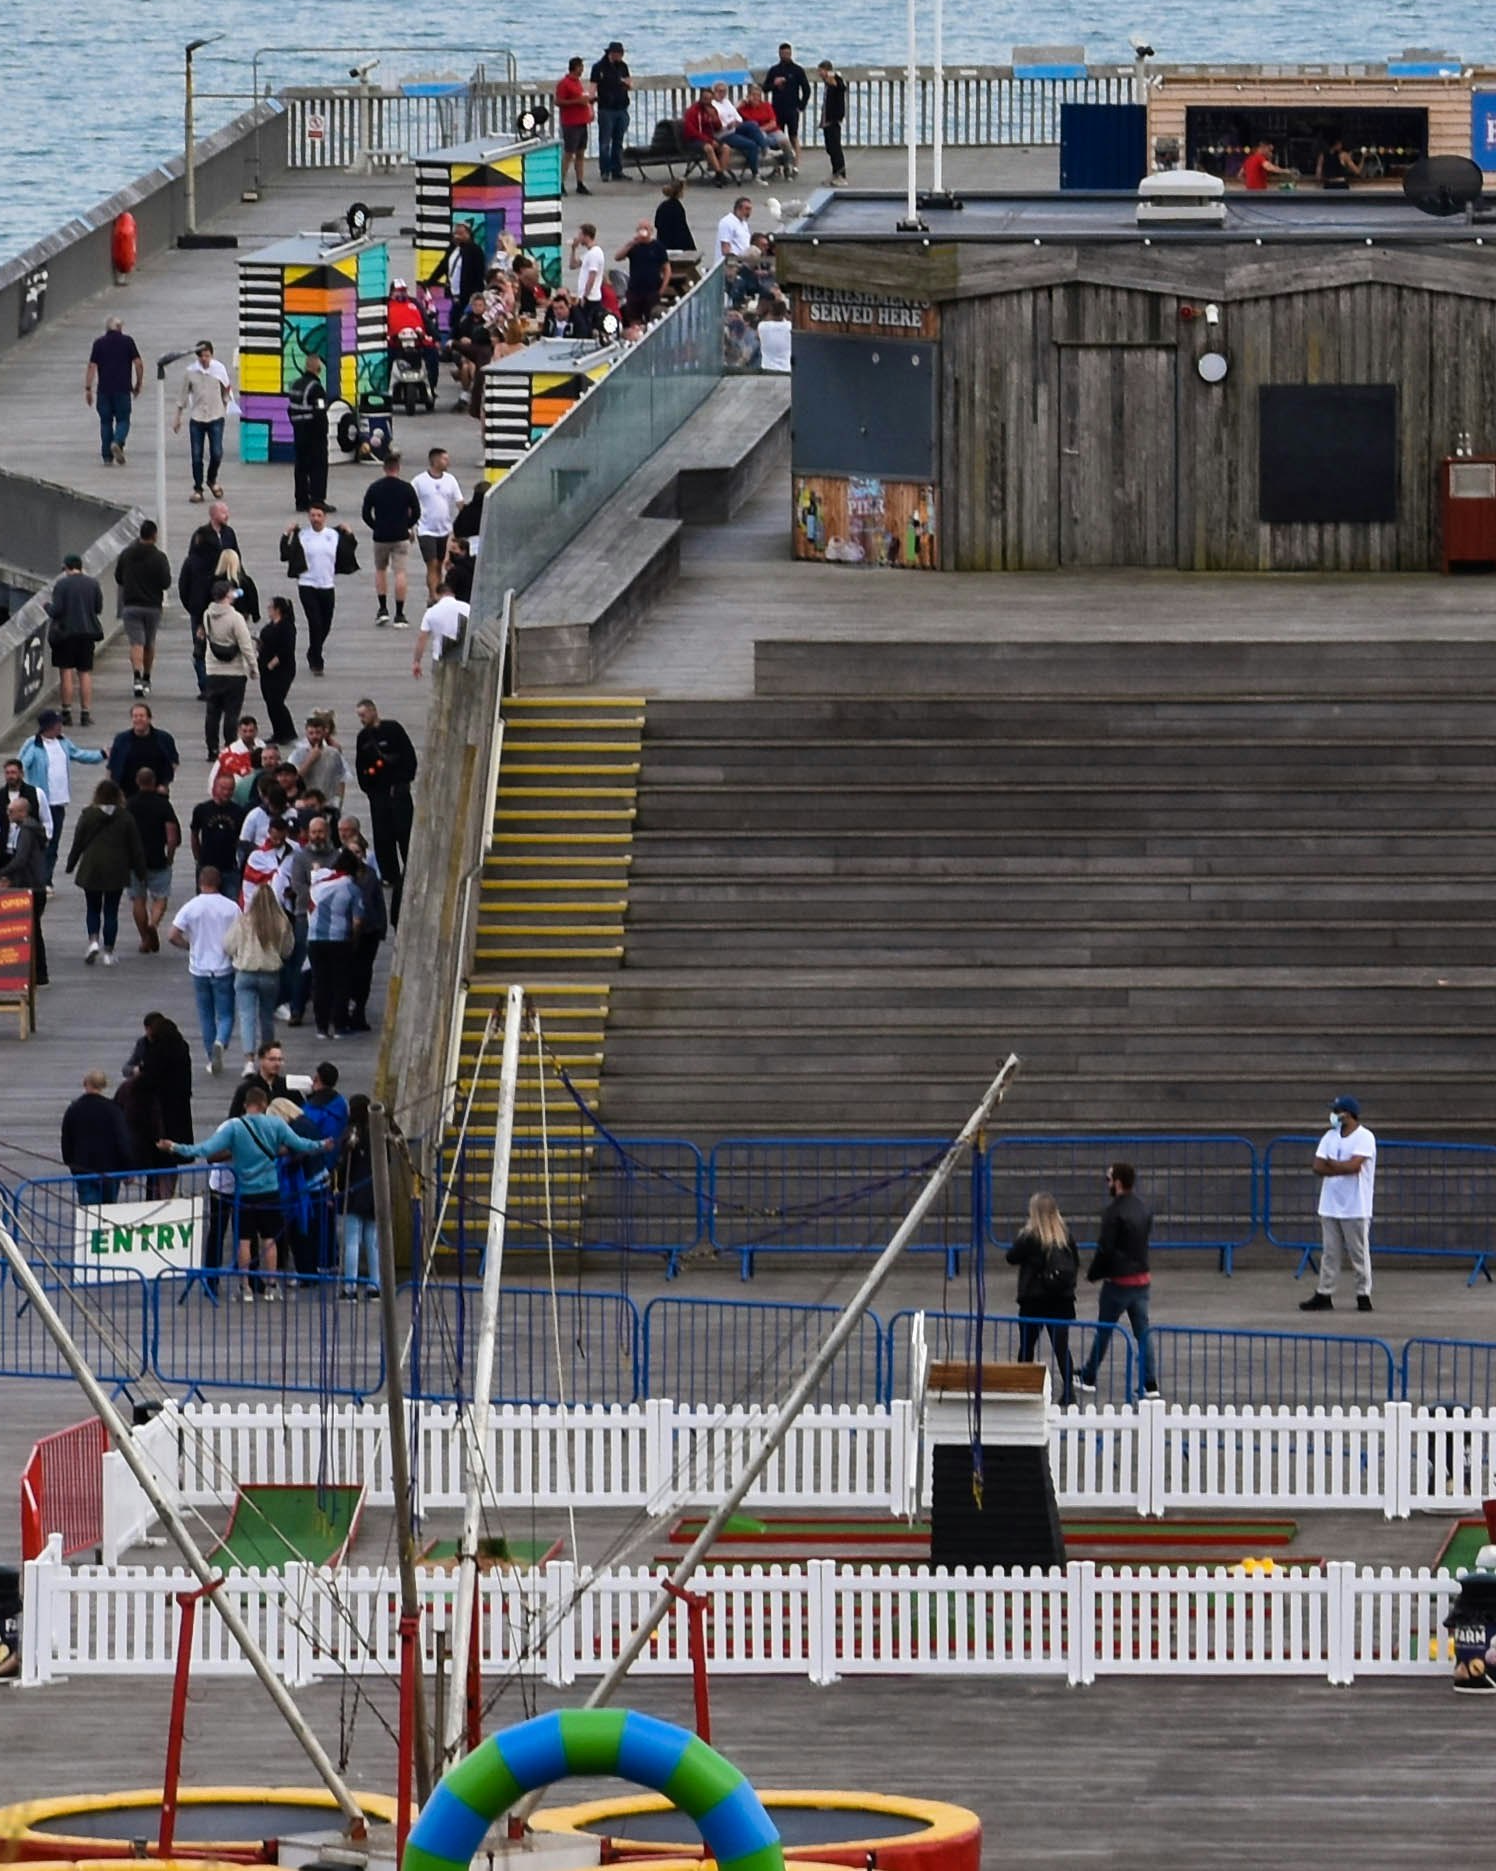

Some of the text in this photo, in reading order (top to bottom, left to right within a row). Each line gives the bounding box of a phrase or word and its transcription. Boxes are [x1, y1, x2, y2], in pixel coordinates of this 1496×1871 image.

[810, 303, 922, 328] SERVED HERE
[90, 1222, 195, 1254] ENTRY
